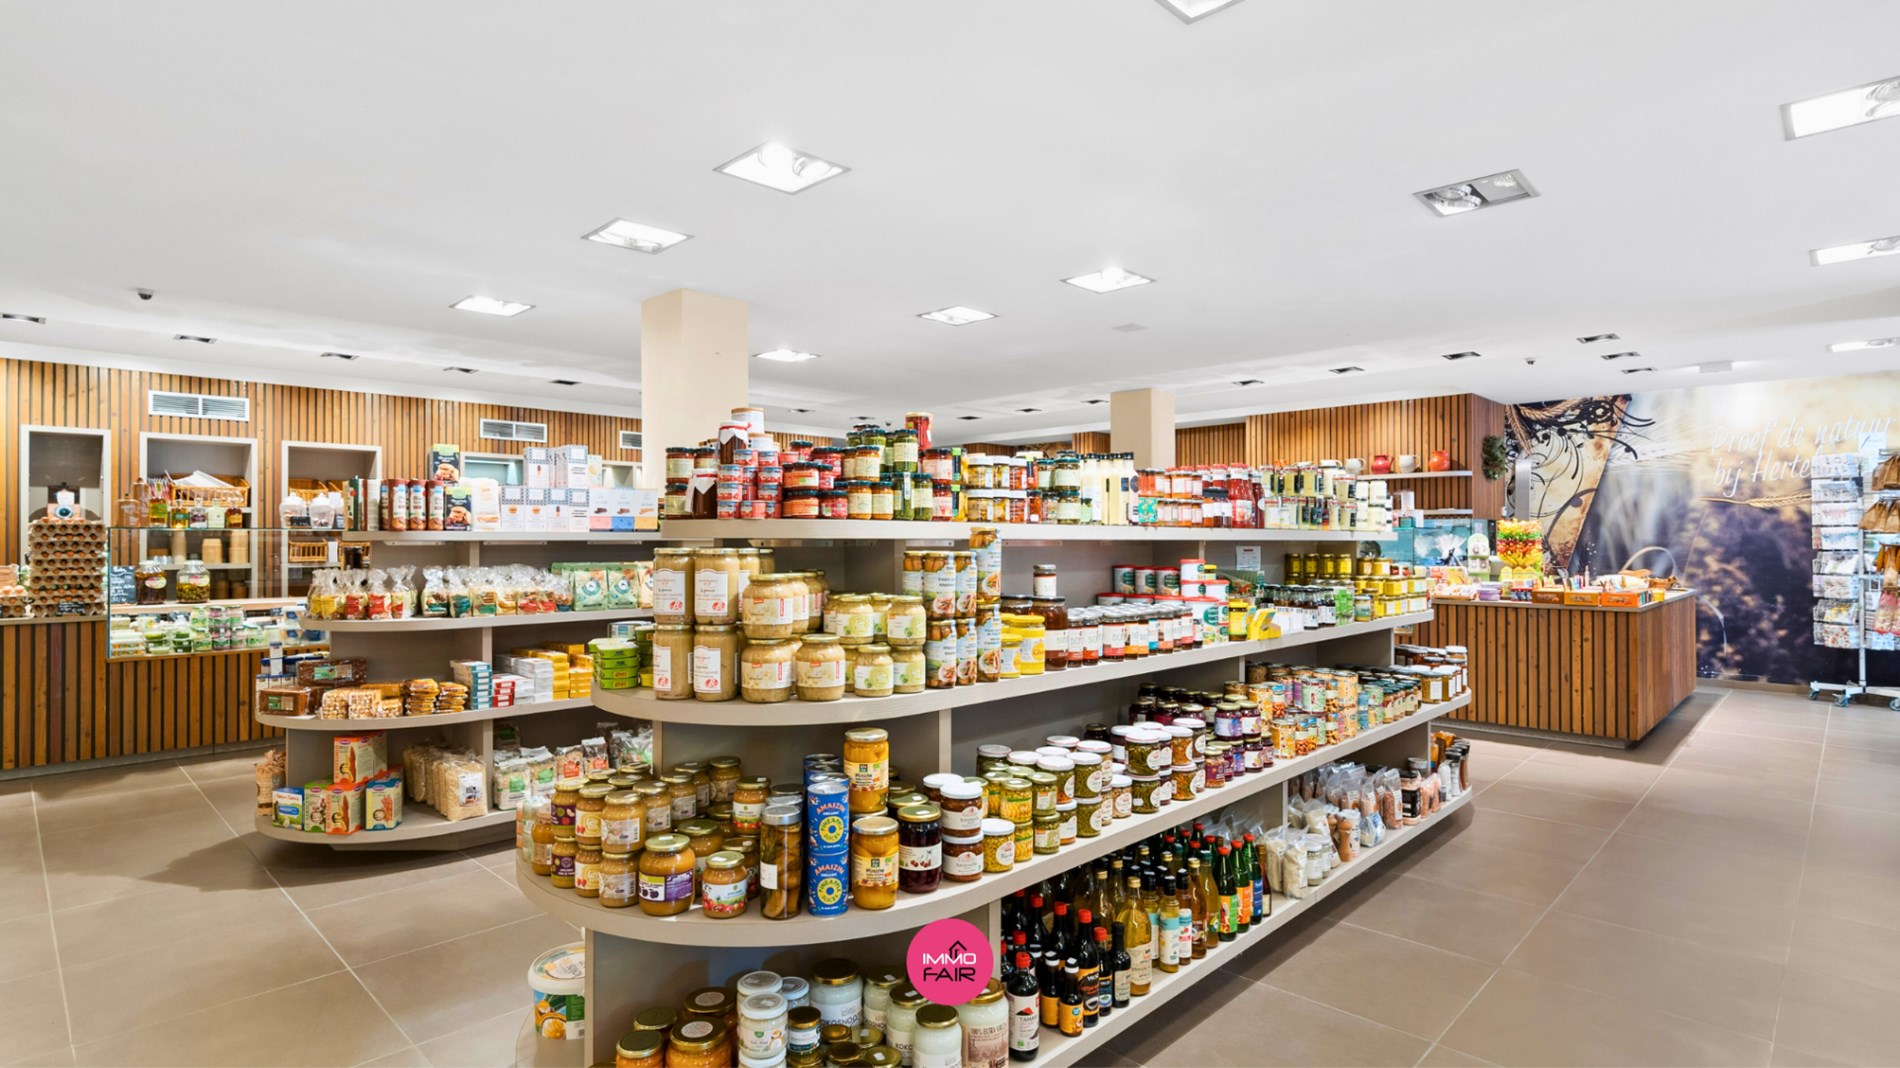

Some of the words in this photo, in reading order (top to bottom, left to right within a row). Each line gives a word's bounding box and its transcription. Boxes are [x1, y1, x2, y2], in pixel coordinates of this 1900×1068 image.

[1711, 416, 1776, 456] Proef
[1778, 416, 1805, 449] de
[1814, 414, 1896, 446] natuur
[1712, 456, 1744, 498] bij
[1751, 444, 1823, 483] Herte
[816, 802, 845, 815] AMAIZIN
[815, 864, 844, 876] AMAIZIN
[818, 879, 842, 892] PINEAPPLE
